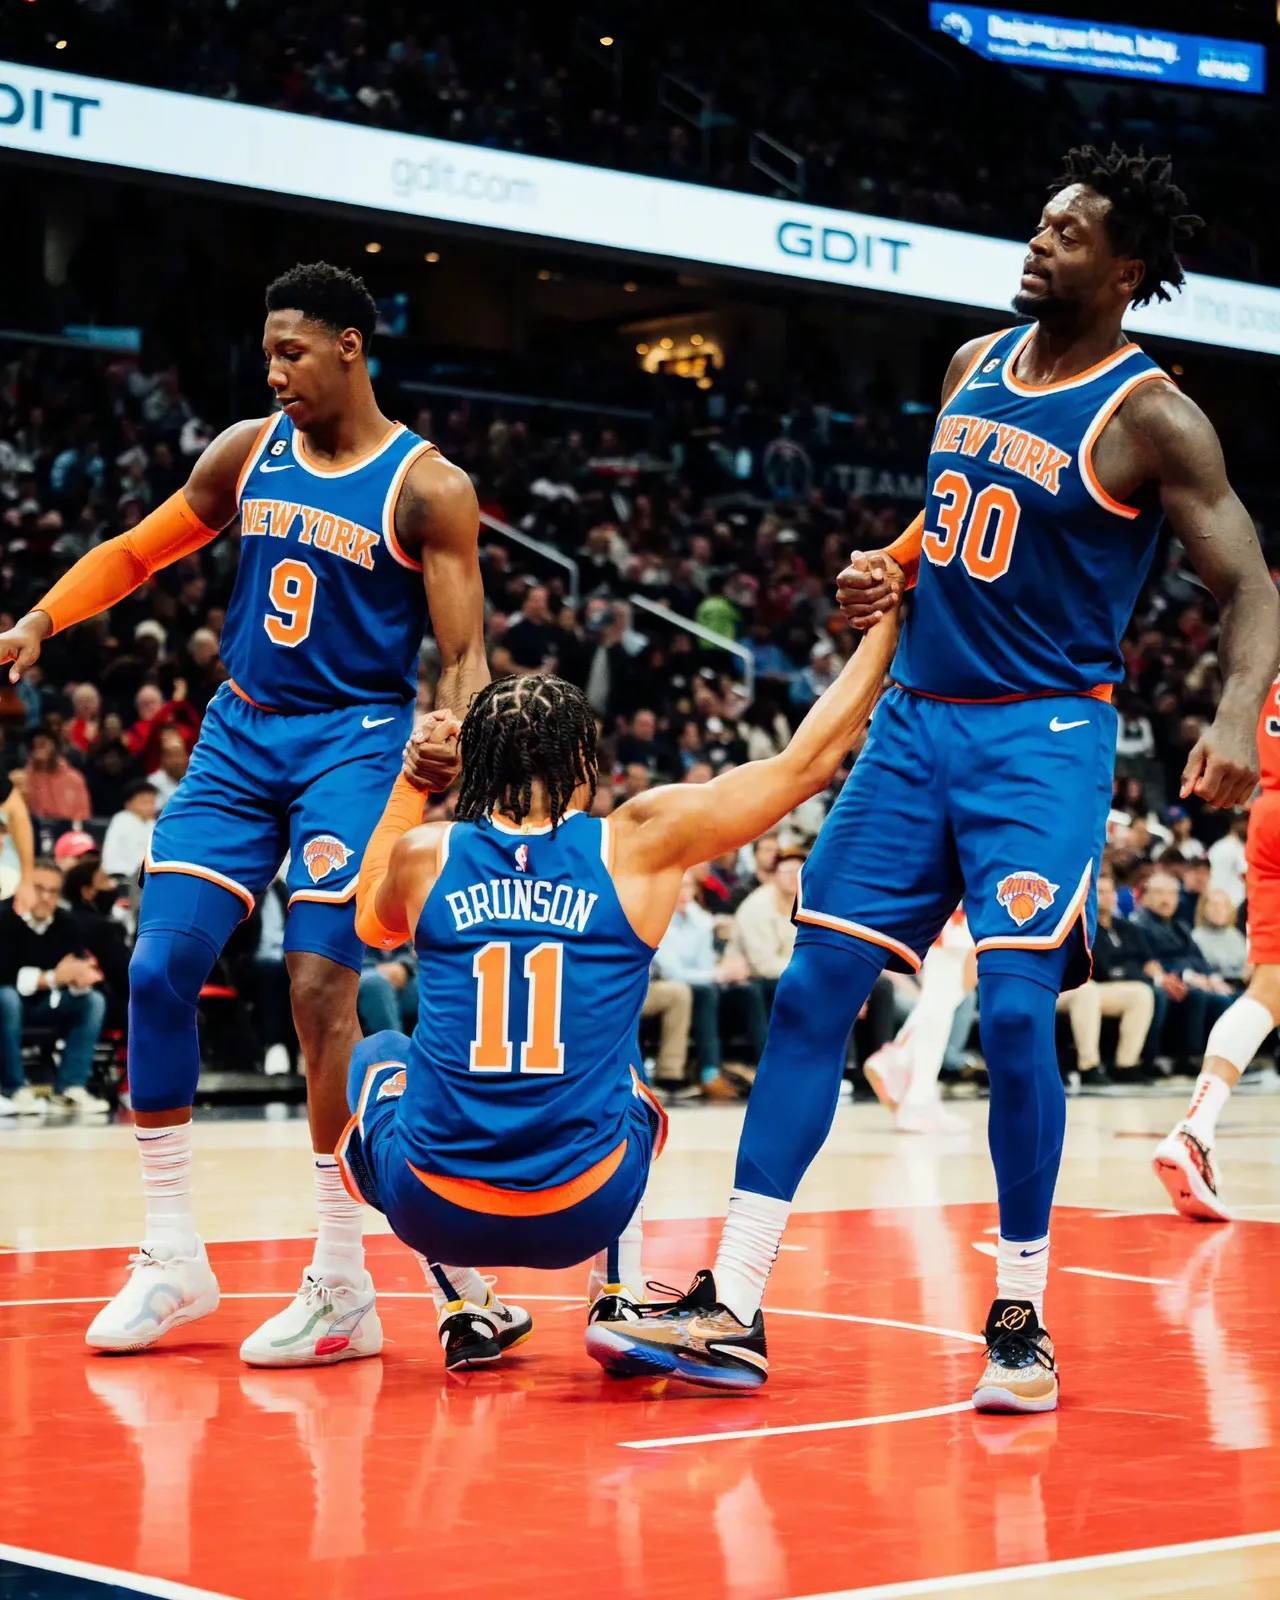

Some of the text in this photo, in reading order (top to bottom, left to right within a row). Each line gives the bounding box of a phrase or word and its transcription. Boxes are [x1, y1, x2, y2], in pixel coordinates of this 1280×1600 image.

[391, 157, 538, 206] gdit.com
[777, 221, 913, 275] GDIT
[982, 358, 1000, 373] 6
[270, 439, 287, 456] 6
[931, 414, 1072, 496] NEW YORK
[241, 498, 381, 571] NEW YORK
[921, 469, 1021, 583] 30
[264, 558, 318, 648] 9
[445, 878, 598, 933] BRUNSON
[469, 941, 565, 1074] 11
